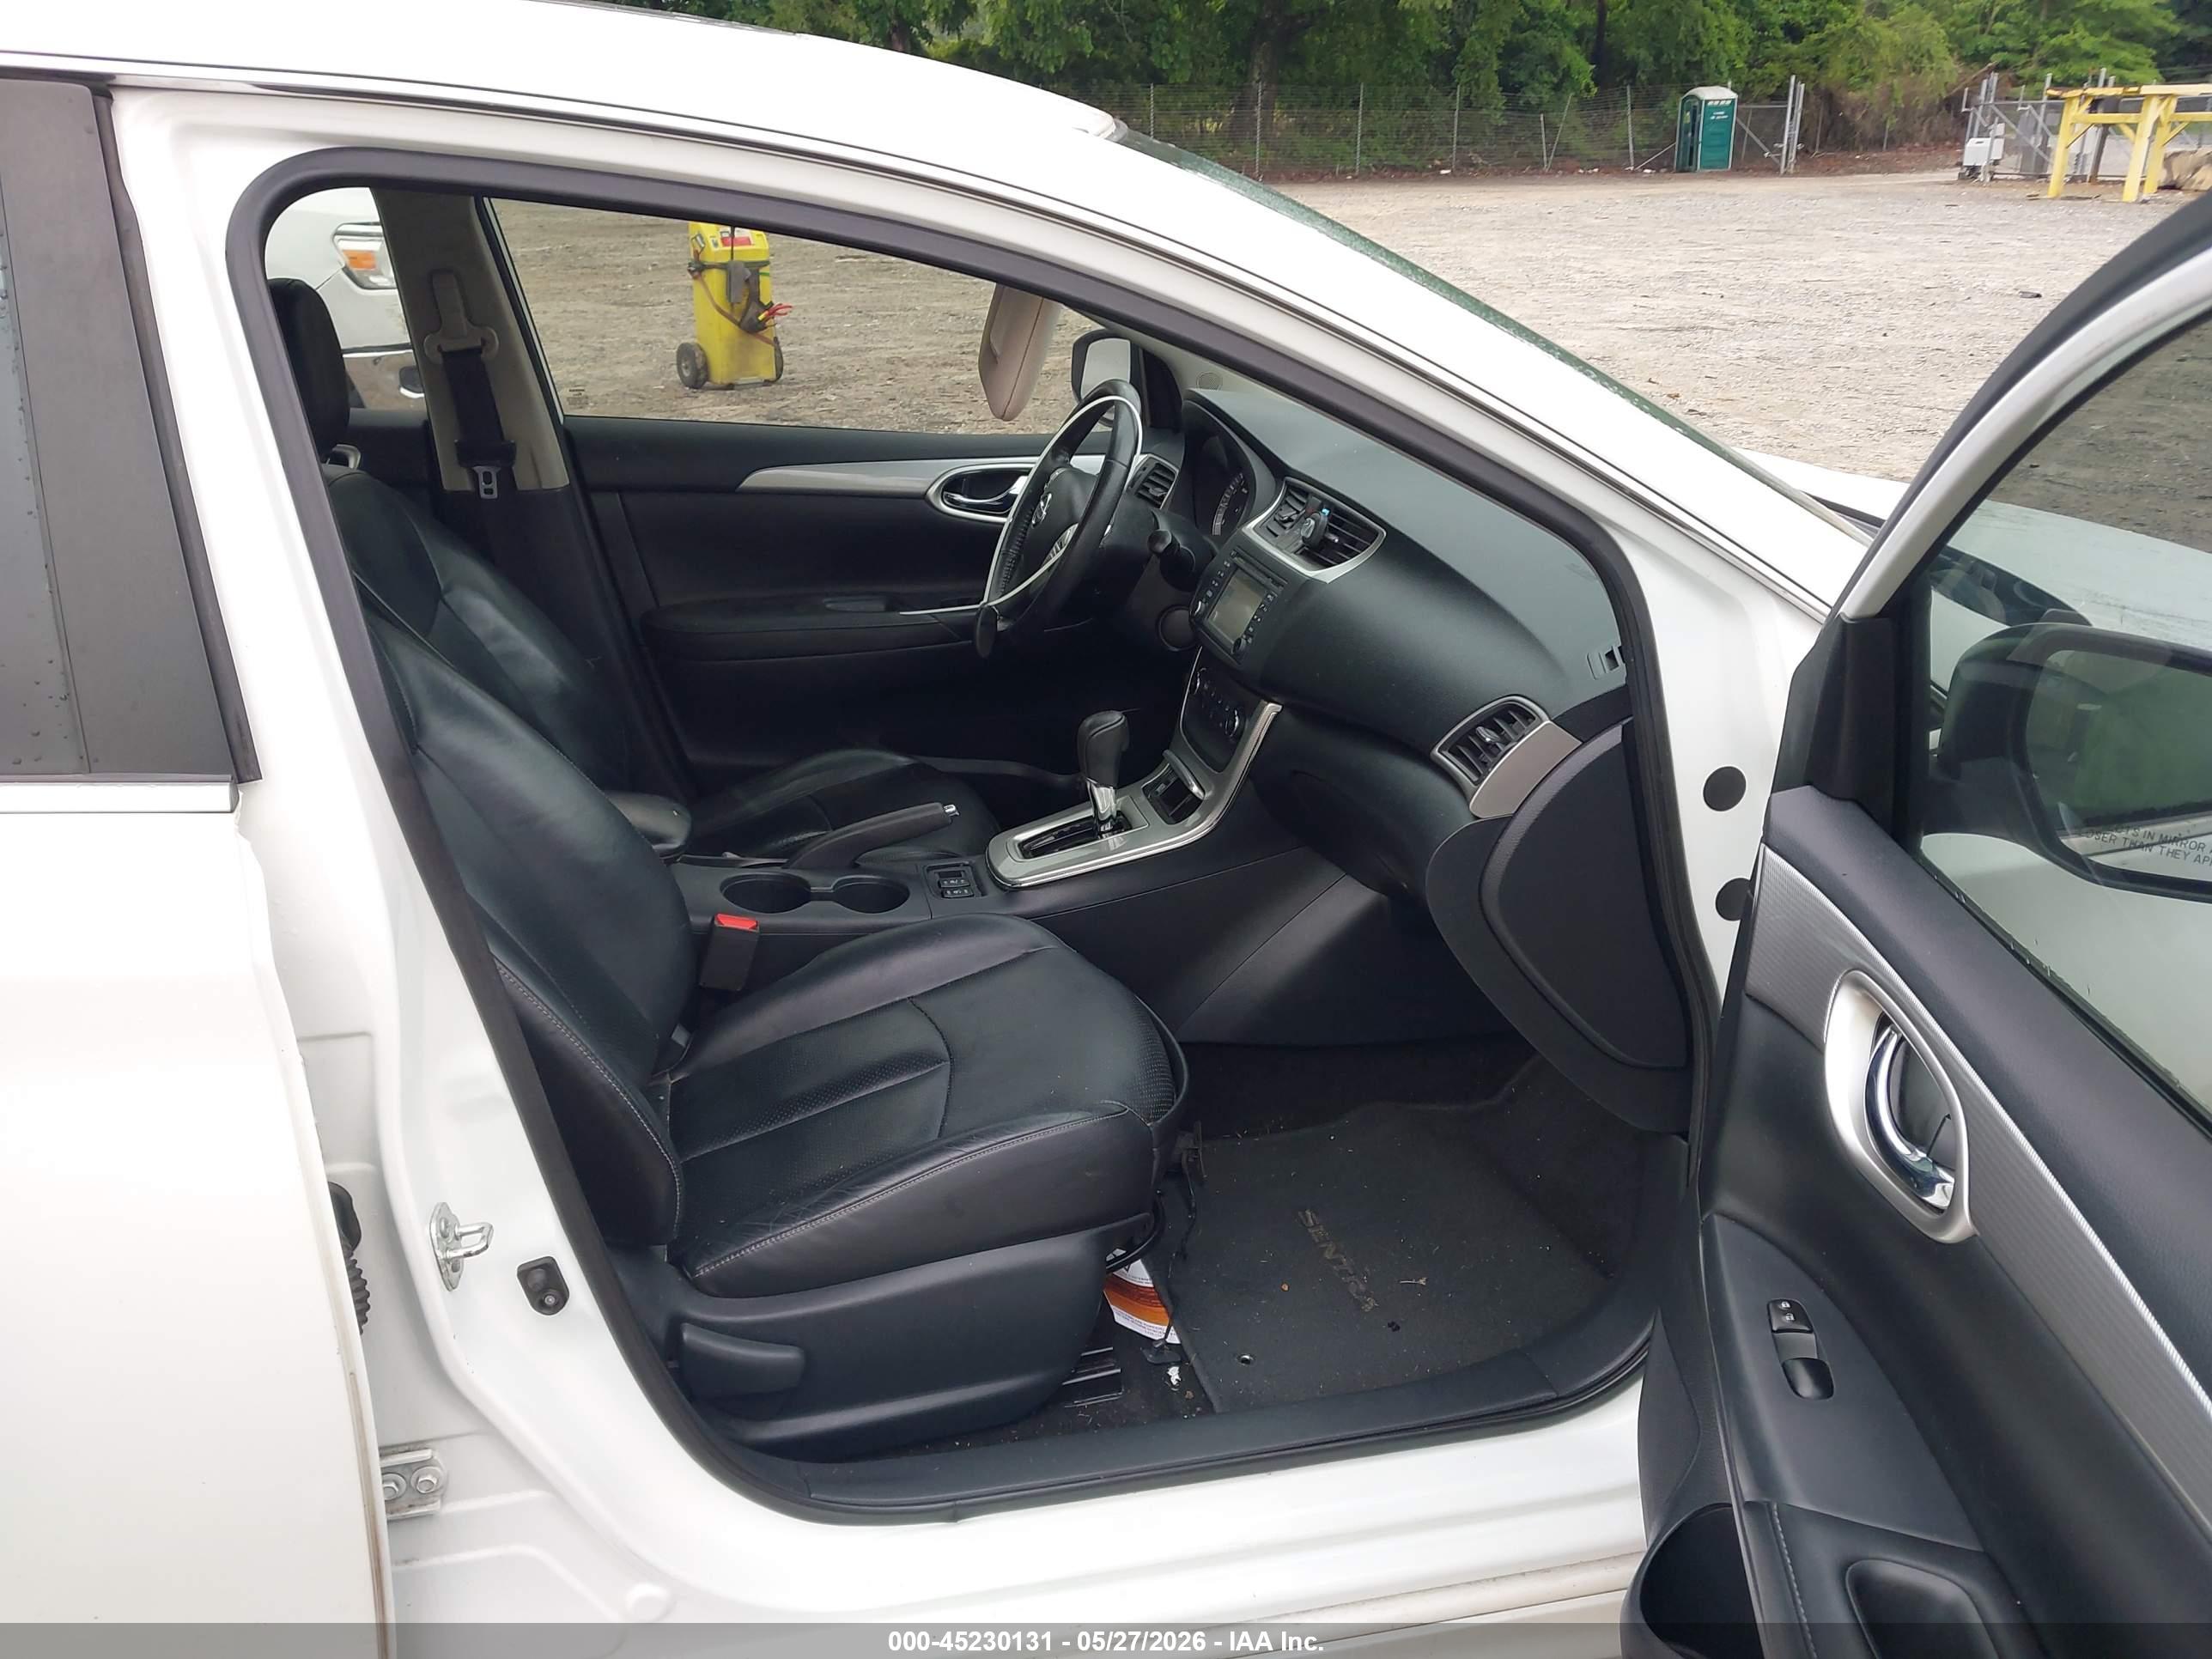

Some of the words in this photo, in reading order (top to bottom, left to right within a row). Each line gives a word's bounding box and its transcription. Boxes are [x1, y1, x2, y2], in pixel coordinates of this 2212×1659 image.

[2122, 836, 2154, 852] THAN
[2159, 845, 2191, 860] THEY
[2142, 830, 2156, 841] IN
[2158, 833, 2206, 853] MIRROR
